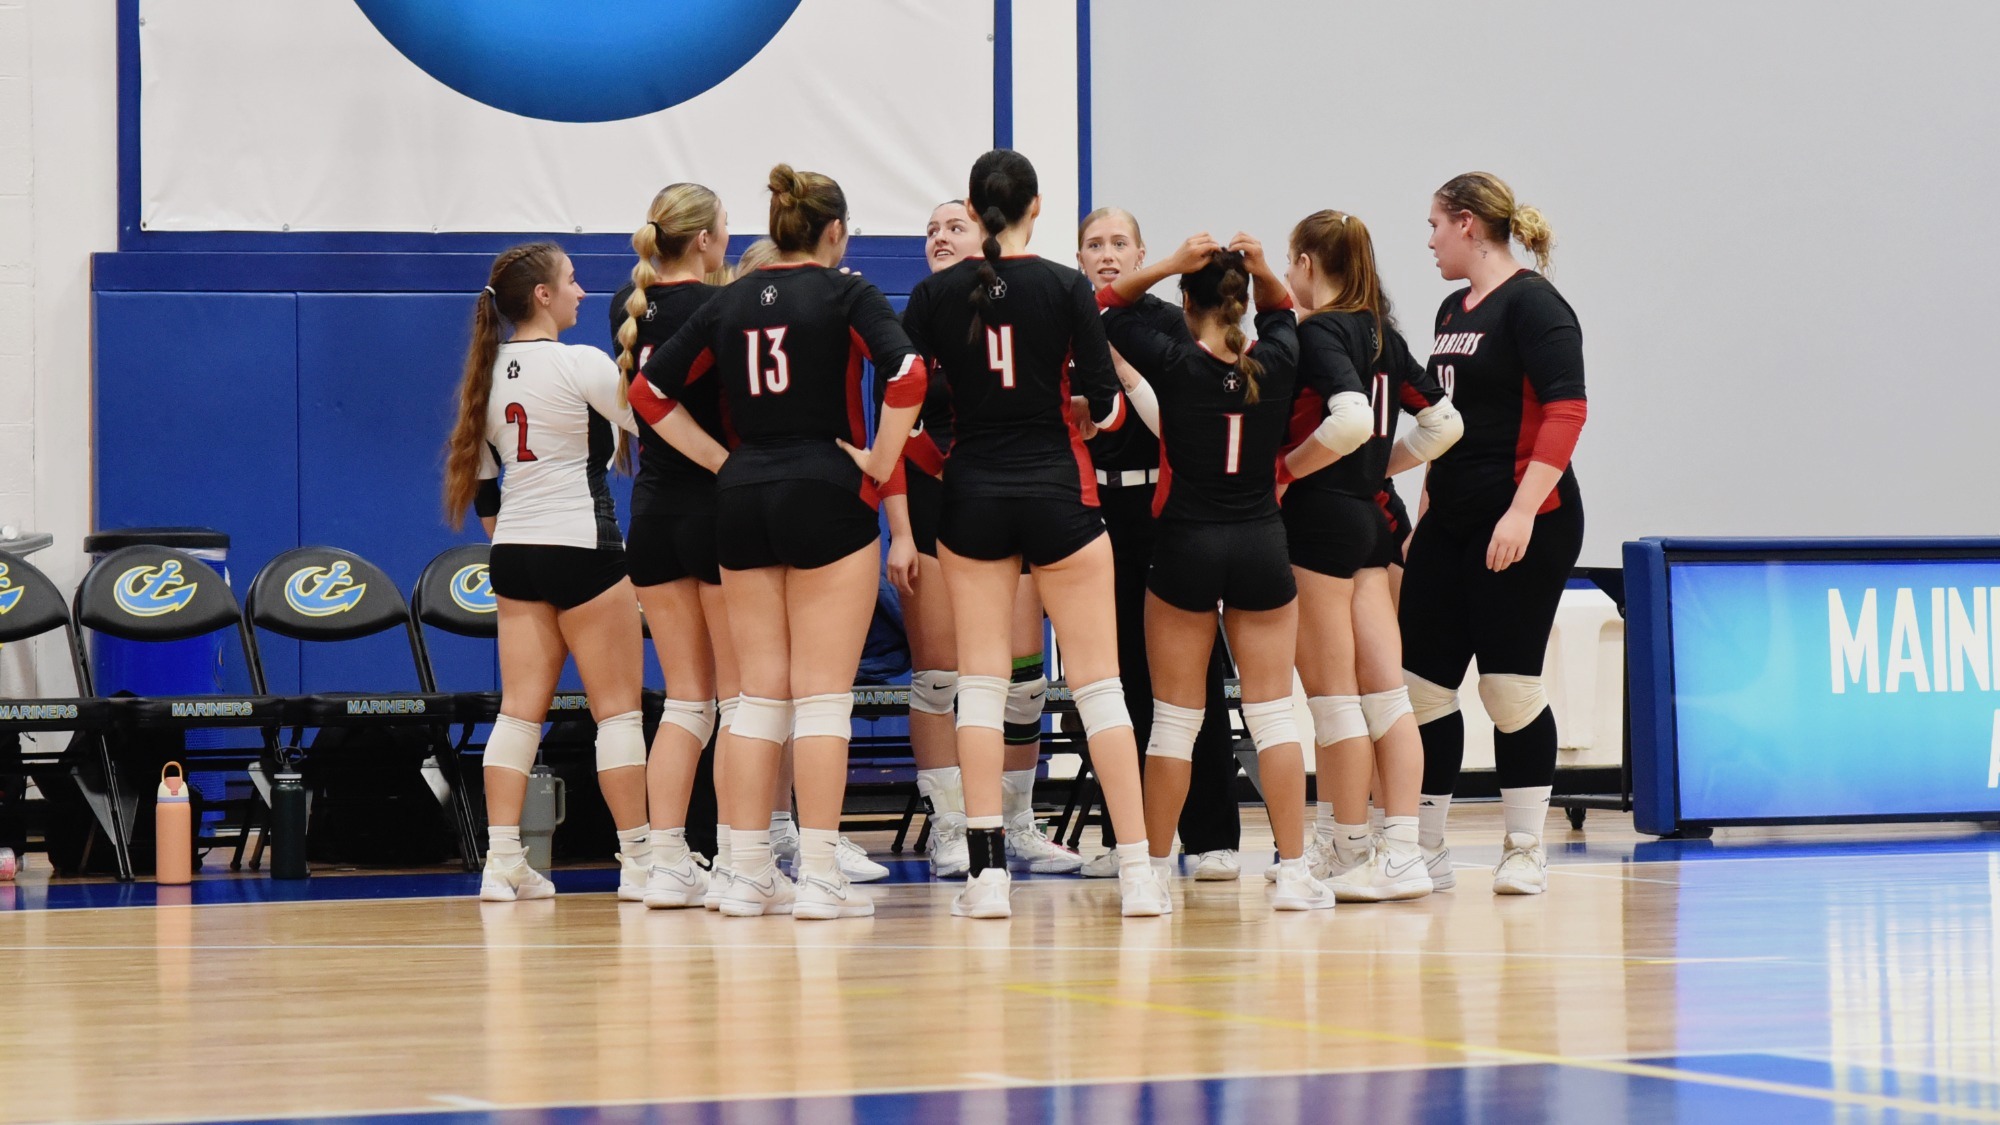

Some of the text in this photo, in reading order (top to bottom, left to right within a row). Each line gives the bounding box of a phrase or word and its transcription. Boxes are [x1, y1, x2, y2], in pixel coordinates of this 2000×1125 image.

[744, 325, 789, 396] 13
[986, 324, 1016, 388] 4
[505, 402, 538, 462] 2
[1224, 412, 1244, 474] 1
[0, 704, 78, 719] MARINERS
[171, 702, 253, 717] MARINERS
[347, 700, 426, 714] MARINERS
[549, 695, 590, 710] INER
